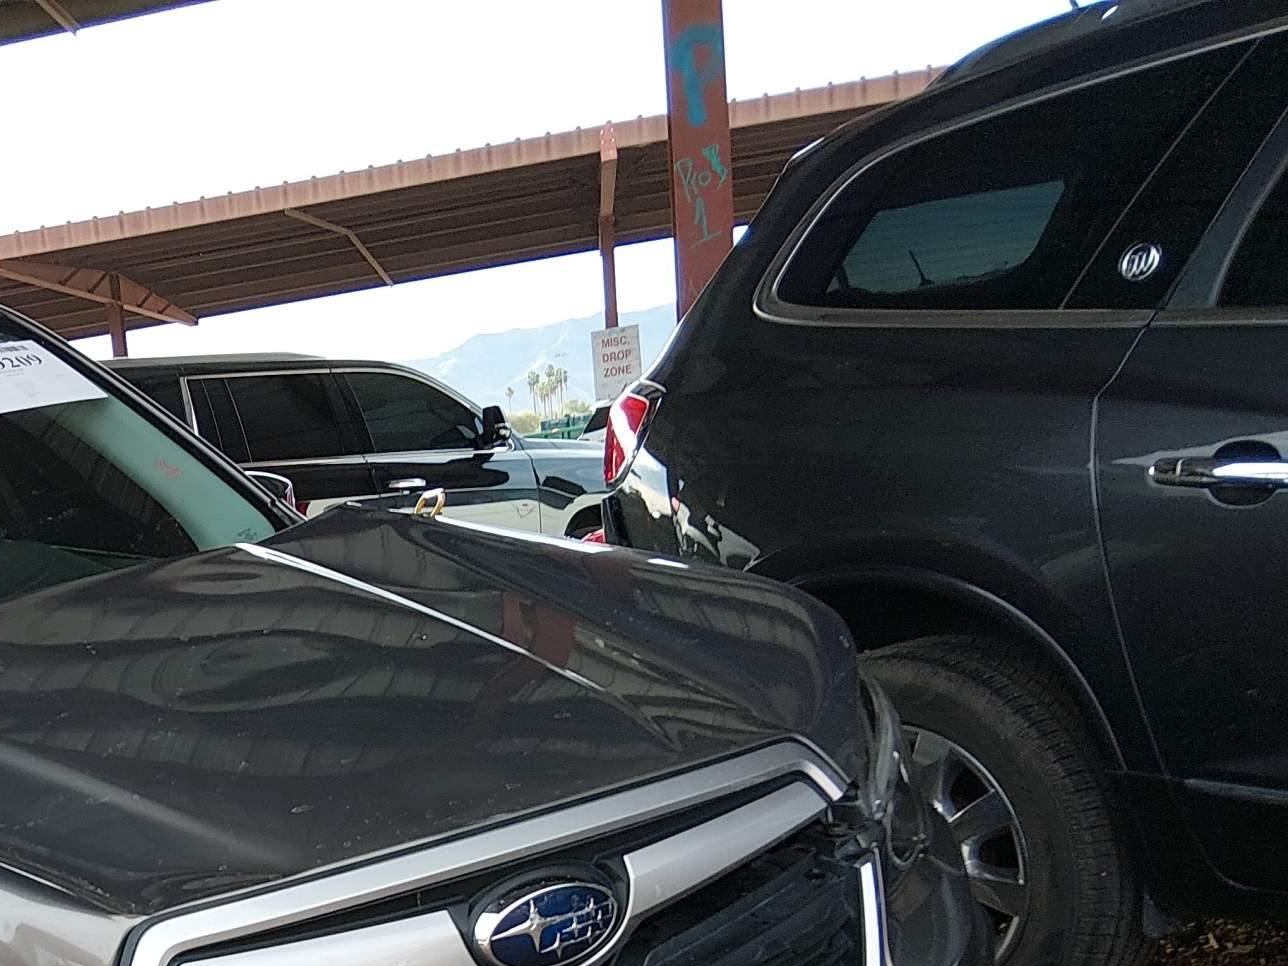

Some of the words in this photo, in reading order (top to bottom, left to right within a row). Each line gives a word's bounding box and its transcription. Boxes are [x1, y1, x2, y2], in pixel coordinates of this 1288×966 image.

[601, 335, 630, 349] MISC.
[602, 349, 632, 363] DROP
[603, 364, 632, 378] ZONE
